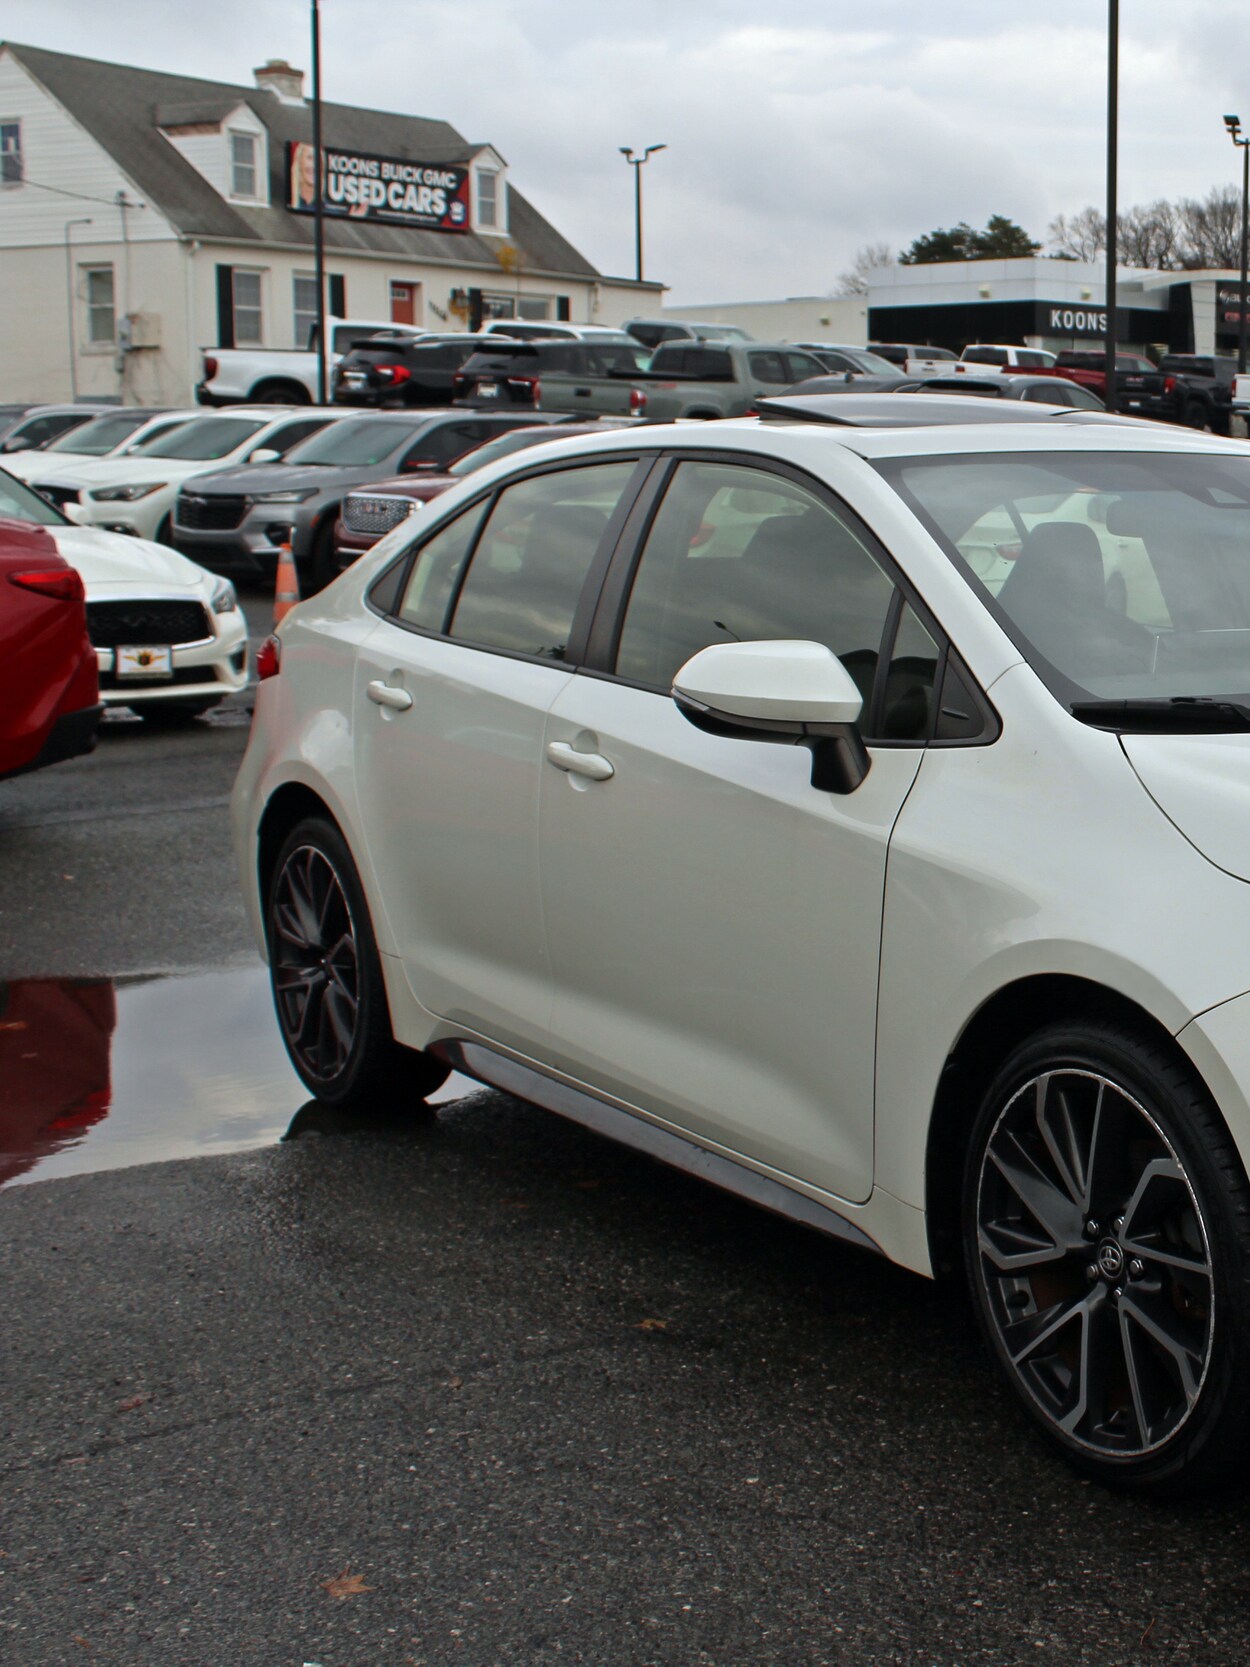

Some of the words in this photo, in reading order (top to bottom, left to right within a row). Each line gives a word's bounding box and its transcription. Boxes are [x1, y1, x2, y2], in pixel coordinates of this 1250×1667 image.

[328, 154, 379, 178] KOONS
[381, 161, 422, 184] BUICK
[423, 168, 457, 190] GMC
[328, 172, 386, 207] USED
[387, 181, 448, 216] CARS
[1051, 309, 1107, 331] KOONS
